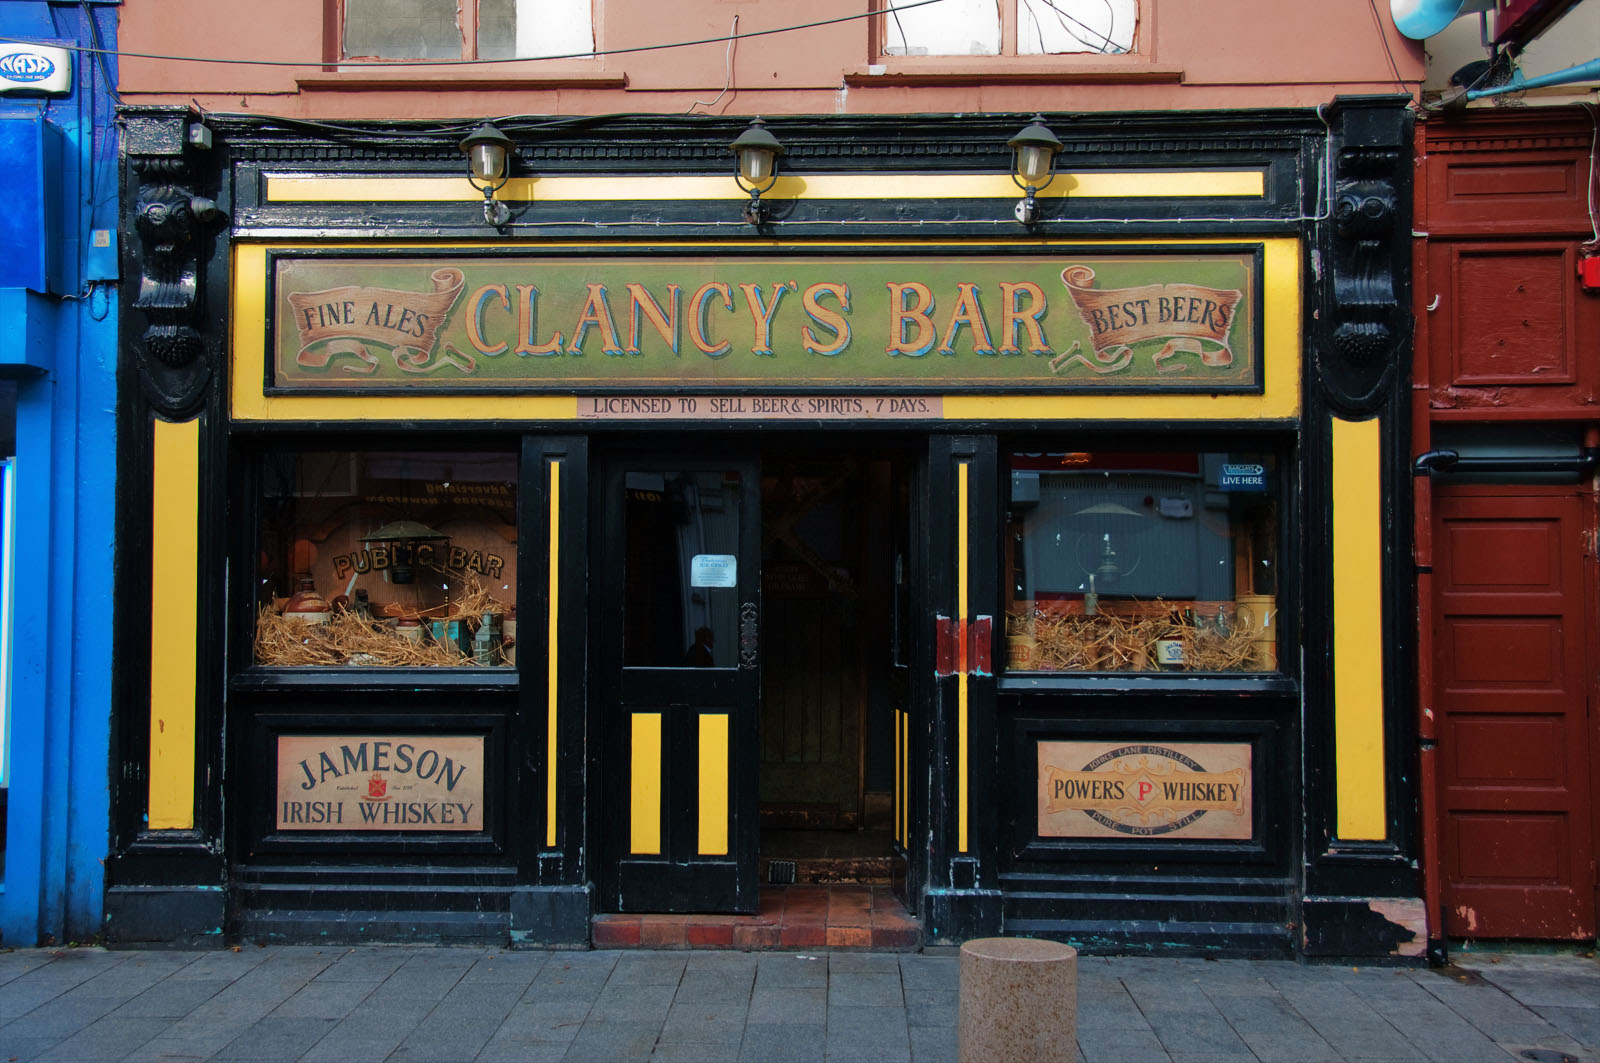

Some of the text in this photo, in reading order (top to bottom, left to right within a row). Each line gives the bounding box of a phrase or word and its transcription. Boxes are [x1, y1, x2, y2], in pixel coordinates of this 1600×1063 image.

[1, 54, 50, 74] NASA
[303, 301, 429, 337] FINE ALES
[465, 281, 1055, 358] CLANCY'S BAR
[1091, 296, 1231, 335] BEST BEERS
[593, 398, 671, 413] LICENSED
[678, 398, 697, 413] TO
[710, 398, 747, 413] SELL
[876, 399, 884, 412] 7
[889, 398, 930, 413] DAYS.
[1222, 476, 1263, 485] LIVE HERE
[449, 546, 504, 579] BAR
[298, 741, 467, 792] JAMESON
[1118, 746, 1142, 756] LANE
[1147, 746, 1198, 767] DISTILLERY
[1054, 779, 1240, 802] POWERS P WHISKEY
[282, 801, 474, 825] IRISH WHISKEY
[1091, 812, 1201, 836] PURE POT STILL
